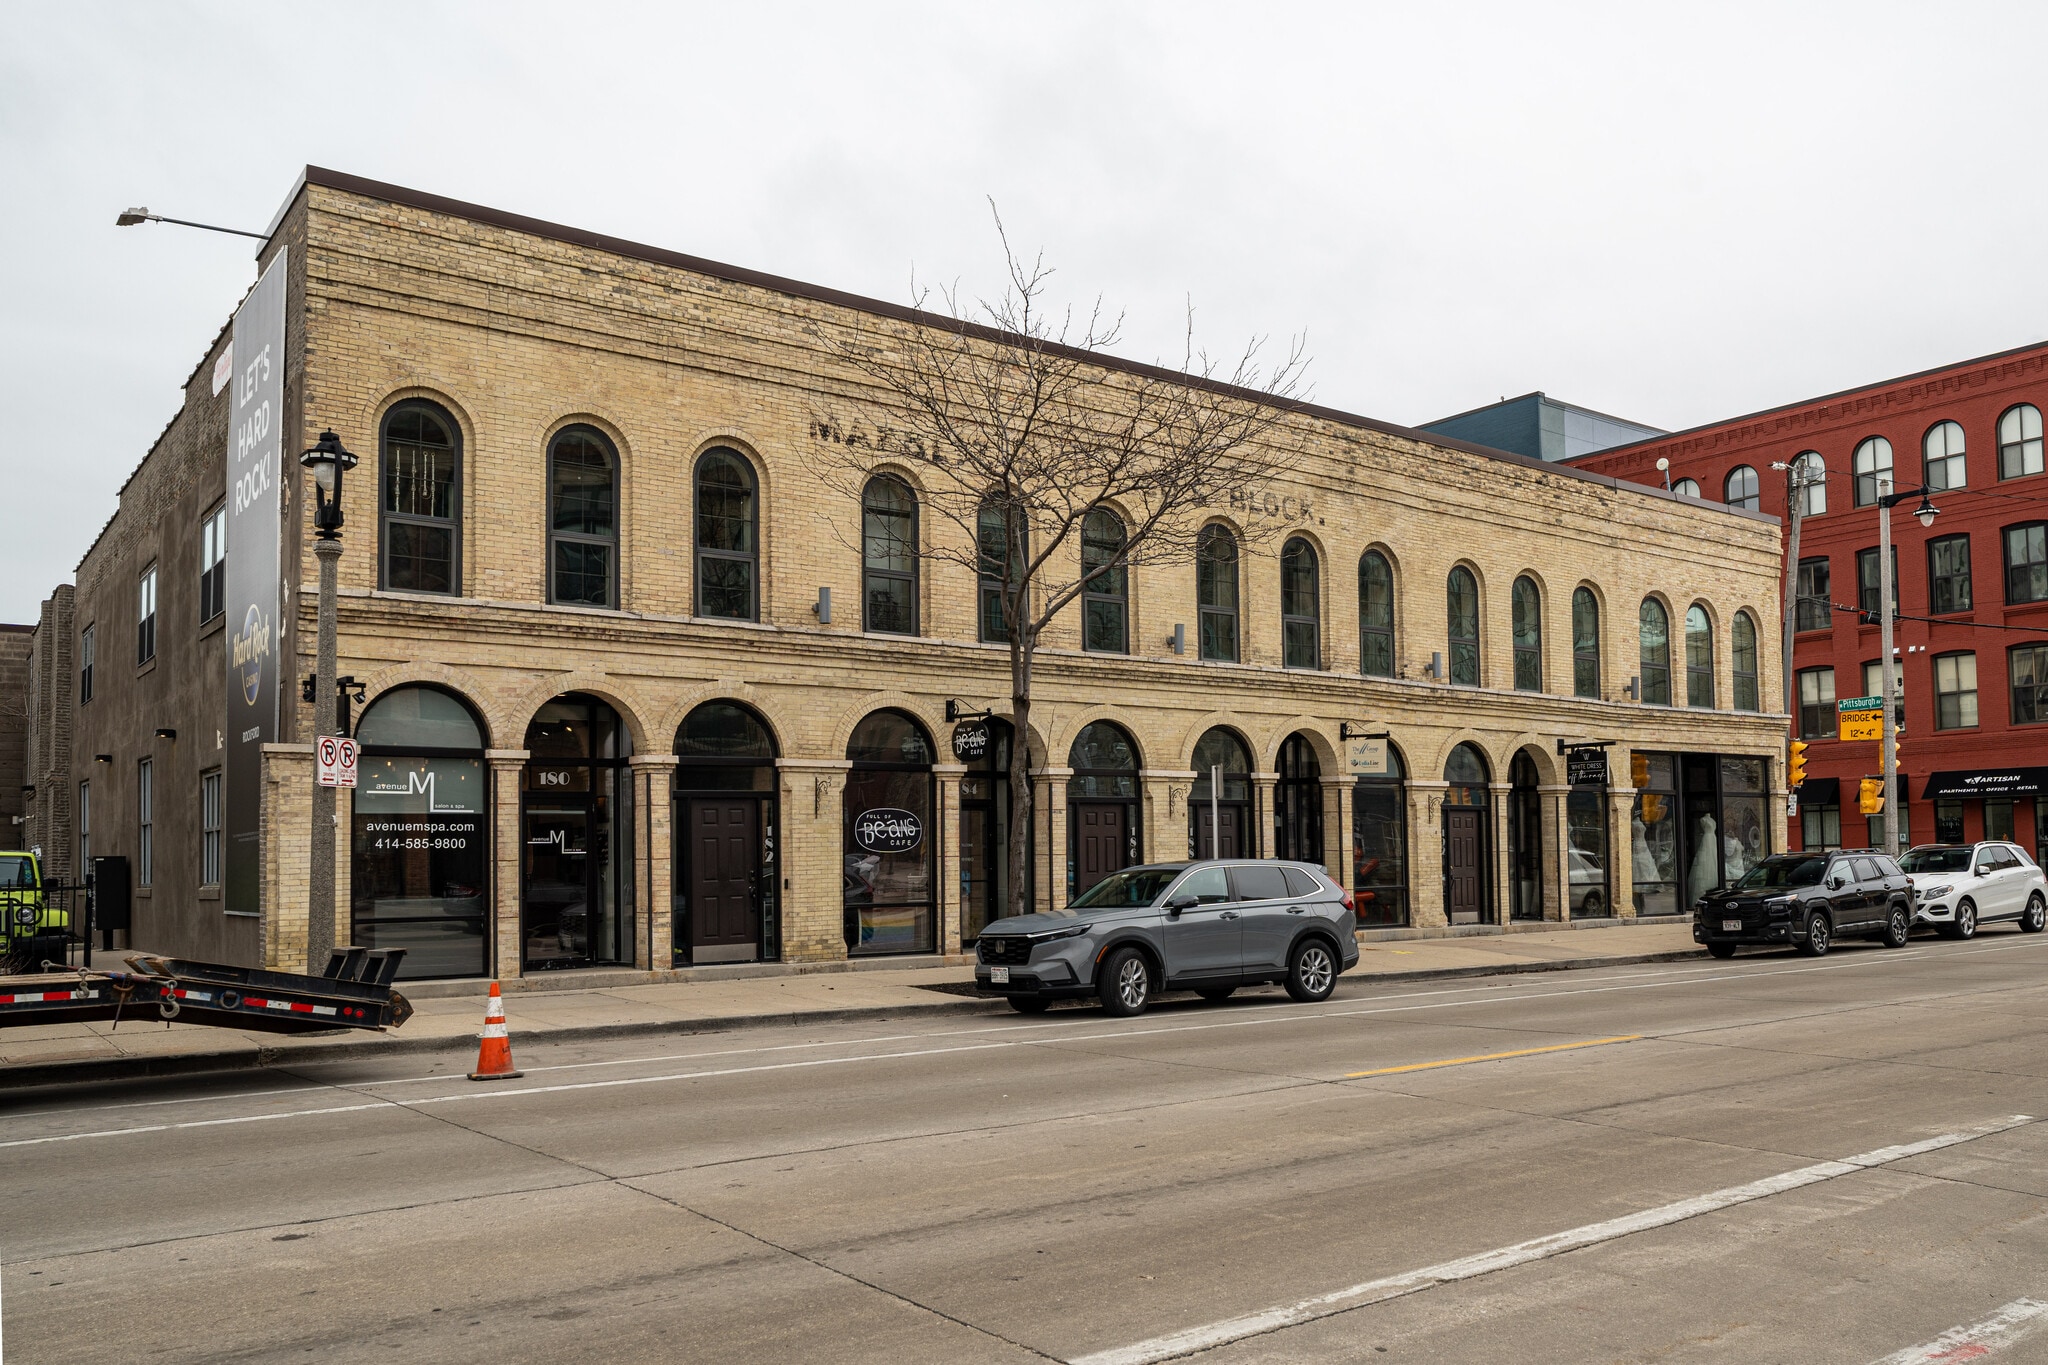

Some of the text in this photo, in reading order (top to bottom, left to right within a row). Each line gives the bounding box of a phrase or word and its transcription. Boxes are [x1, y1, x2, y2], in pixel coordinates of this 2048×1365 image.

[240, 344, 270, 409] LET'S
[238, 400, 270, 462] HARD
[235, 451, 271, 516] ROCK!
[232, 614, 270, 670] Hard Rock
[1842, 698, 1876, 708] Pittsburgh
[1841, 714, 1870, 722] BRIDGE
[538, 771, 570, 785] 180
[375, 783, 408, 791] avenue
[366, 822, 475, 833] avenuemspa.com
[375, 838, 466, 849] 414-585-9800
